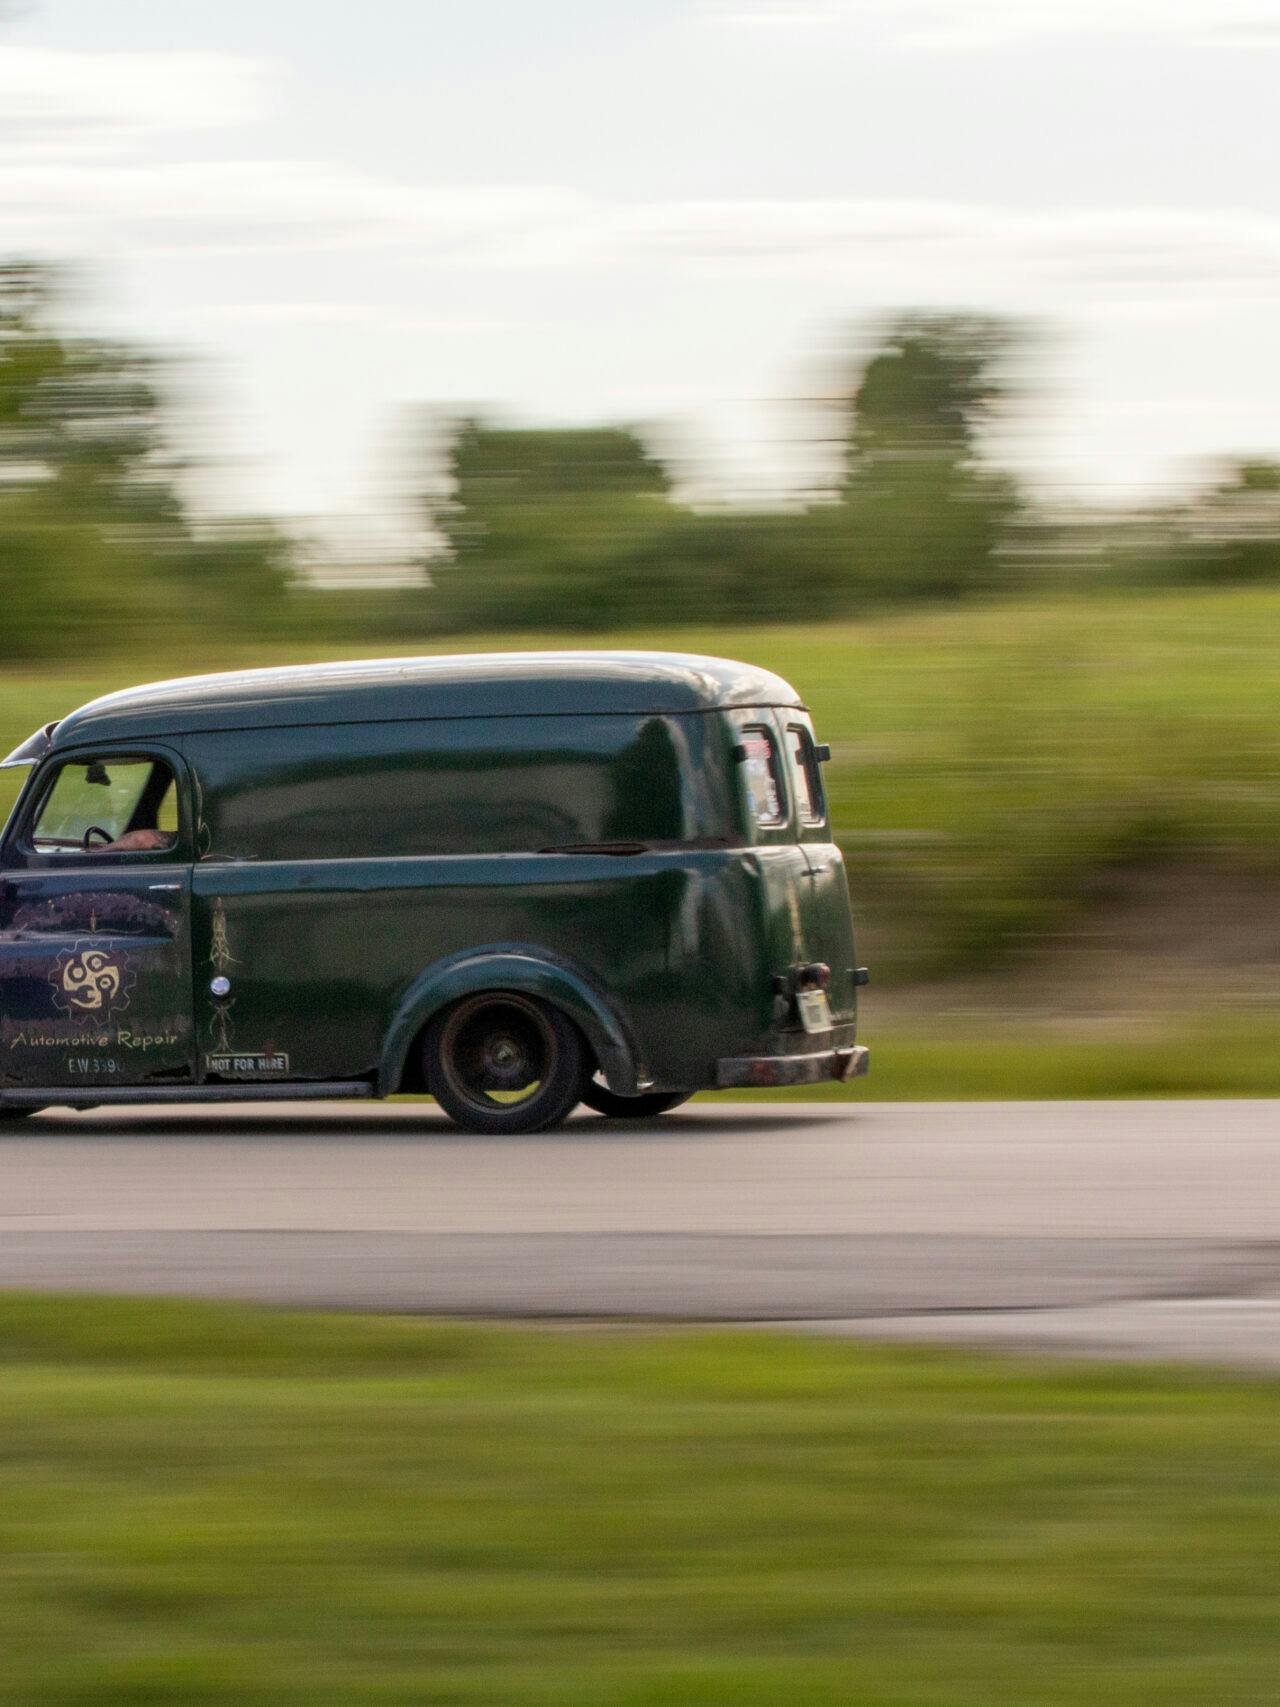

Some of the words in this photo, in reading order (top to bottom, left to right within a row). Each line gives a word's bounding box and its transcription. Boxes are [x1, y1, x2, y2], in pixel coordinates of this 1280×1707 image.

[10, 1032, 109, 1048] Automotive
[117, 1030, 178, 1051] Repair
[211, 1058, 231, 1071] NOT
[233, 1058, 255, 1070] FOR
[258, 1057, 285, 1070] HIRE
